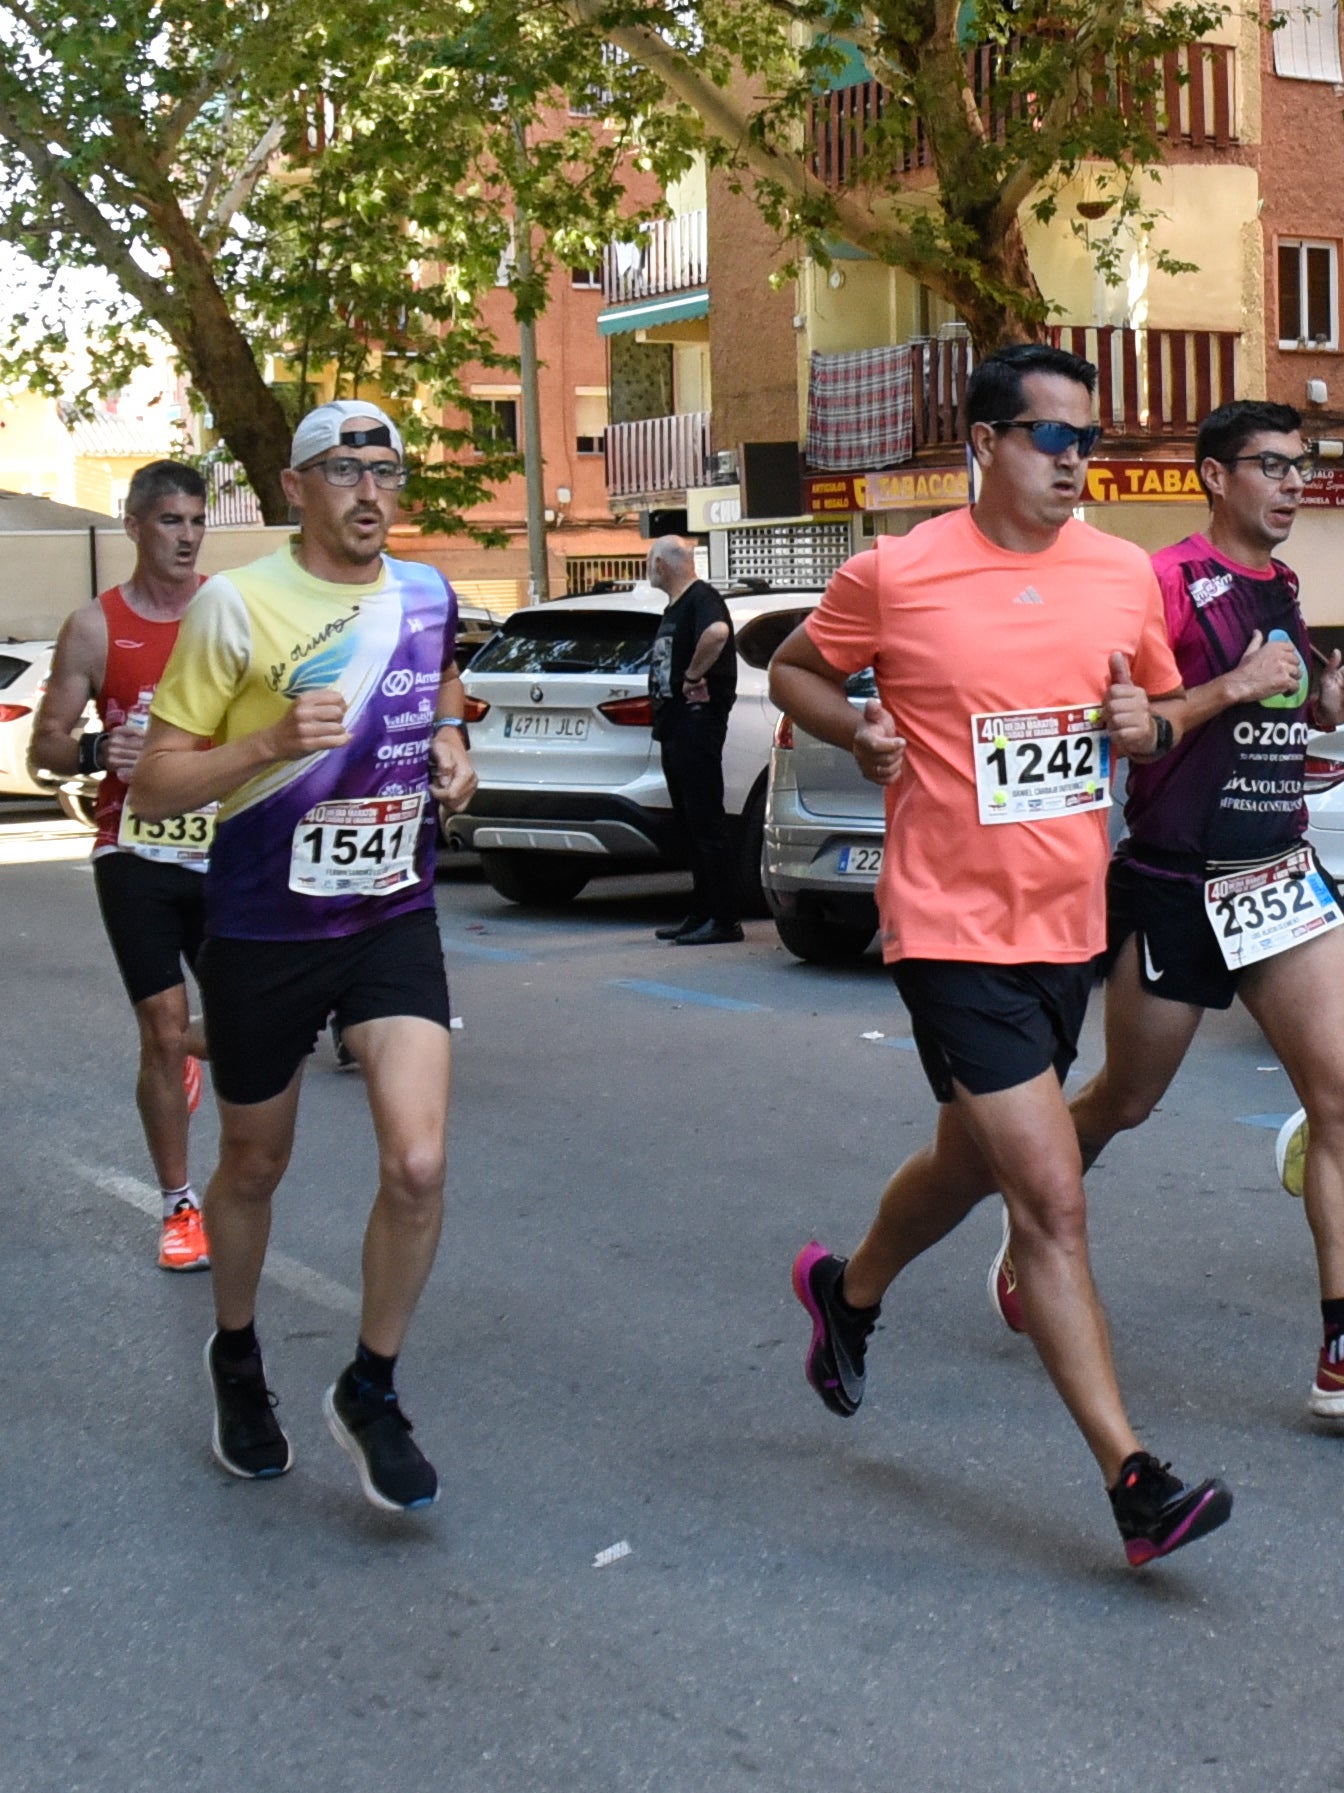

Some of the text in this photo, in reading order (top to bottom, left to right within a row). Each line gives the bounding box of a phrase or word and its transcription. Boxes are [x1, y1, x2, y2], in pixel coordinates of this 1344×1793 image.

[514, 715, 585, 737] 4711 JLC
[981, 718, 1004, 741] 40
[986, 736, 1094, 786] 1242
[303, 825, 404, 866] 1541
[1215, 880, 1315, 939] 2352
